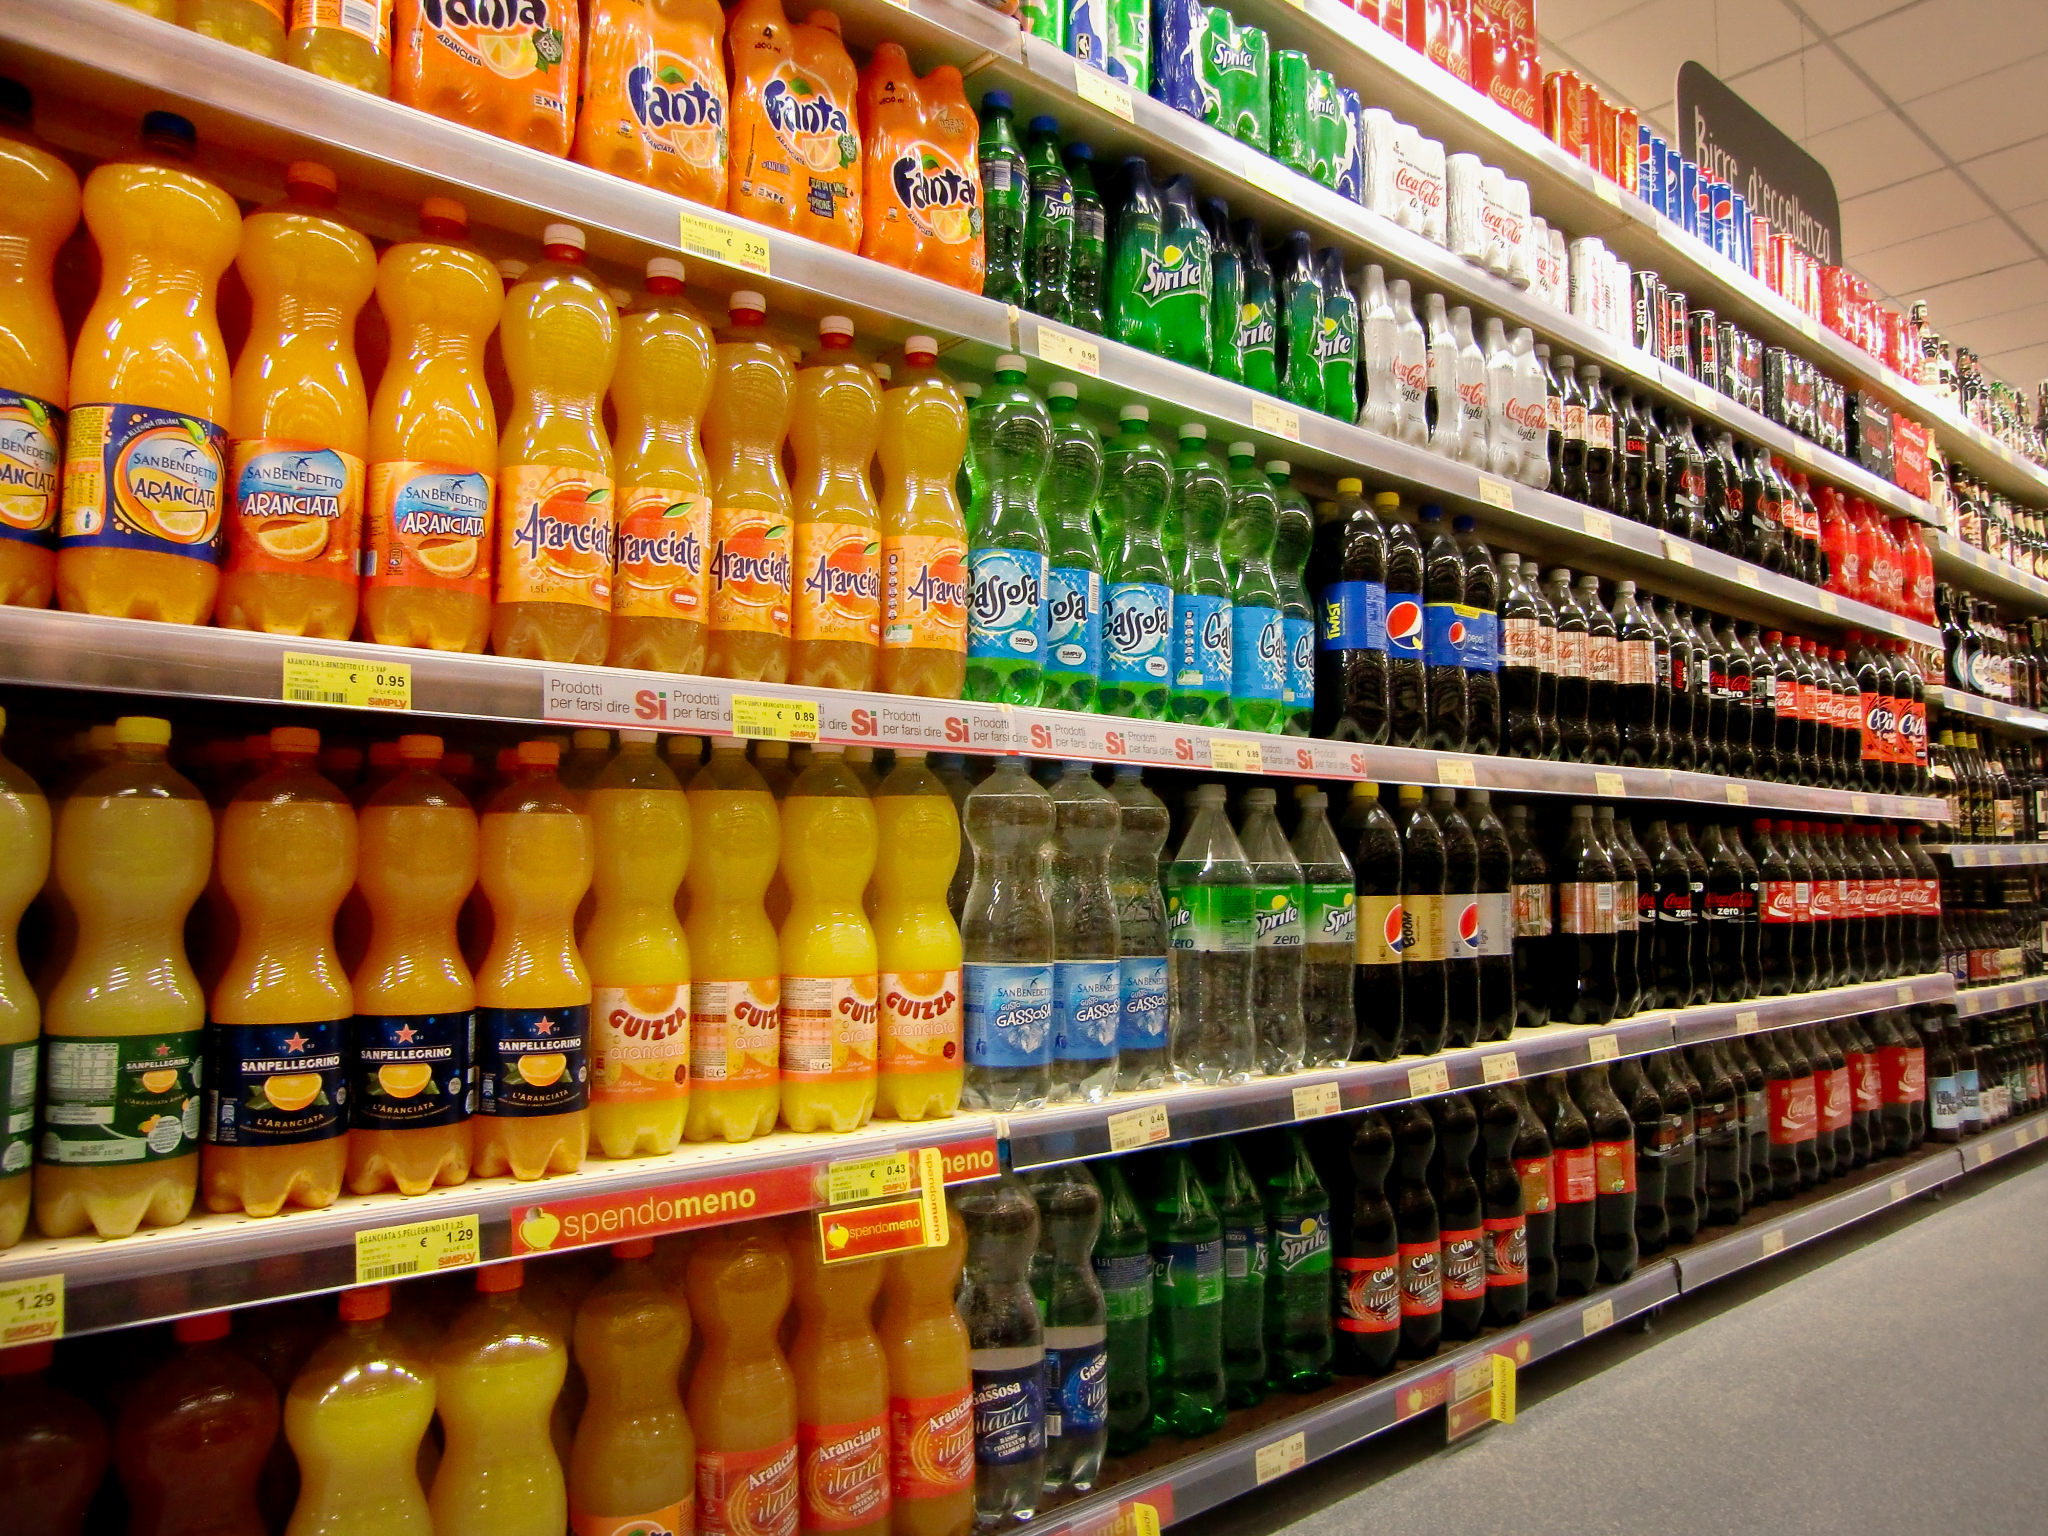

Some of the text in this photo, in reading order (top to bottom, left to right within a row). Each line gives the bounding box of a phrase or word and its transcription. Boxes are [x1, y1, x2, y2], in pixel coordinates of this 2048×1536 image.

[436, 33, 483, 67] ARANCIATA
[1213, 42, 1253, 75] Sprite
[628, 66, 722, 128] Fanta
[1490, 75, 1535, 119] Coca-Cola
[764, 79, 848, 135] Fanta
[776, 135, 805, 166] ARANCIATA
[1695, 105, 1738, 184] Birre
[894, 157, 976, 210] Fanta
[1396, 167, 1444, 208] Coca-Cola
[1482, 206, 1524, 245] Coca-Cola
[745, 243, 765, 257] 3.29
[1143, 262, 1200, 298] Sprite
[1517, 425, 1537, 441] light
[133, 477, 216, 509] ARANCIATA
[243, 492, 341, 518] ARANCIATA
[402, 511, 486, 538] ARANCIATA
[1467, 634, 1484, 645] pepsi
[287, 658, 320, 667] ARANCIATA
[349, 673, 405, 687] € 0.95
[551, 679, 603, 697] Prodotti
[550, 697, 630, 715] per farsi dire
[634, 689, 668, 721] Si
[673, 690, 720, 706] Prodotti
[673, 707, 719, 722] per farsi
[776, 711, 815, 722] € 0.89
[851, 708, 878, 737] Si
[882, 709, 921, 723] Prodotti
[973, 716, 1010, 730] Prodotti
[829, 718, 848, 731] dire
[882, 724, 942, 738] per farsi dire
[944, 717, 970, 743] Si
[1055, 724, 1086, 737] Prodotti
[973, 731, 1028, 744] per farsi dire
[1031, 724, 1053, 749] Si
[1055, 738, 1104, 750] per farsi dire
[1105, 731, 1127, 756] Si
[1128, 731, 1157, 743] Prodotti
[1129, 744, 1173, 756] per farsi dire
[1175, 737, 1194, 761] Si
[1246, 750, 1259, 758] 0.89
[1296, 748, 1314, 771] Si
[1350, 753, 1366, 773] Si
[1717, 907, 1739, 916] zero
[1402, 909, 1414, 949] BOOM
[1273, 934, 1300, 945] zero
[1080, 997, 1099, 1007] GUSTO
[1131, 989, 1148, 999] GUSTO
[885, 990, 956, 1019] GUIZZA
[1000, 1000, 1021, 1012] GUSTO
[608, 1006, 688, 1041] GUIZZA
[887, 1021, 956, 1037] aranciata
[498, 1037, 582, 1051] SANPELLEGRINO
[610, 1041, 686, 1061] aranciata
[360, 1047, 452, 1060] SANPELLEGRINO
[126, 1057, 190, 1070] SANPELLEGRINO
[241, 1055, 341, 1072] SANPELLEGRINO
[512, 1089, 569, 1101] L'ARANCIATA
[372, 1101, 435, 1114] L'ARANCIATA
[256, 1113, 325, 1128] L'ARANCIATA
[886, 1164, 906, 1176] 0.43
[926, 1153, 942, 1243] spendomeno
[563, 1186, 756, 1241] spendomeno
[359, 1232, 396, 1244] ARANCIATA
[397, 1224, 440, 1239] S.PELLEGRINO
[849, 1217, 921, 1239] spendomeno
[420, 1228, 473, 1247] € 1.29
[1281, 1230, 1328, 1261] Sprite
[1450, 1238, 1473, 1254] Cola
[1411, 1253, 1434, 1269] Cola
[1372, 1266, 1394, 1284] Cola
[16, 1292, 56, 1311] 1.29
[818, 1425, 882, 1463] Aranciata
[828, 1453, 883, 1495] ilaria
[848, 1490, 881, 1512] CONTENUTO
